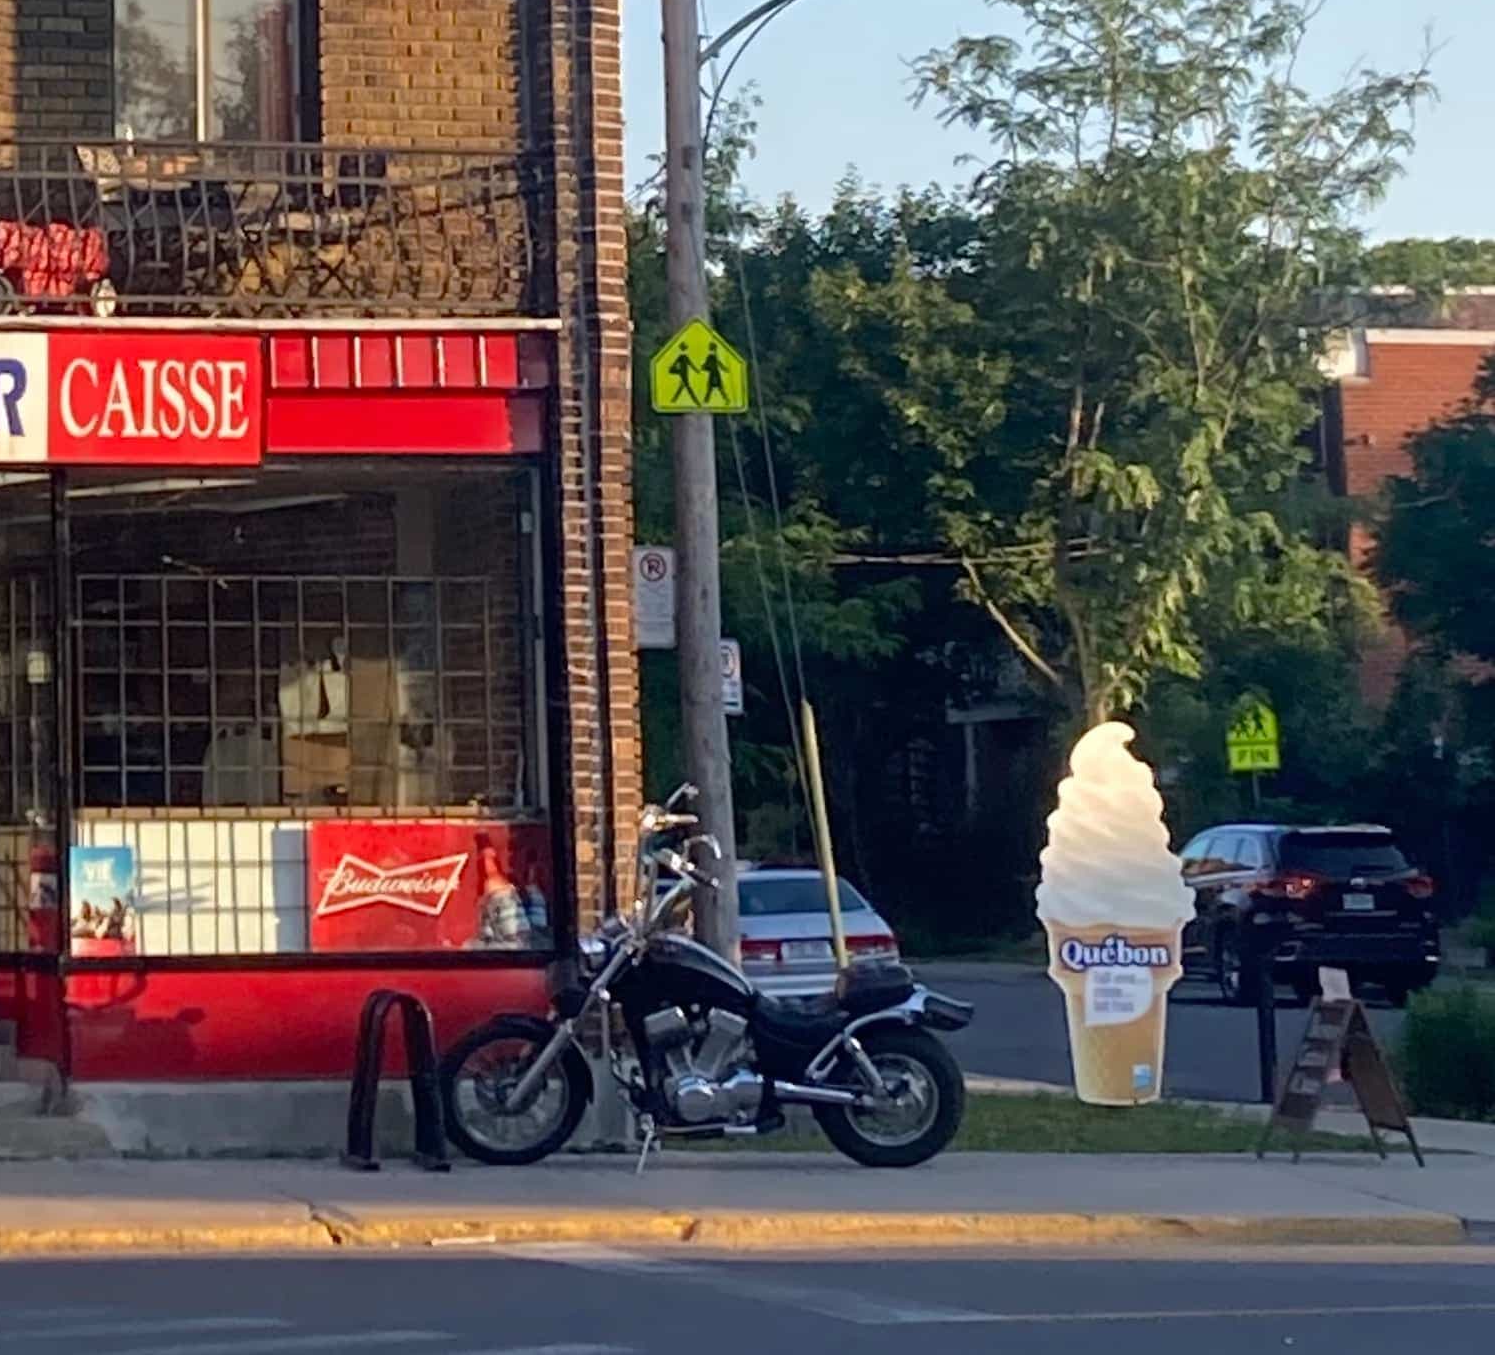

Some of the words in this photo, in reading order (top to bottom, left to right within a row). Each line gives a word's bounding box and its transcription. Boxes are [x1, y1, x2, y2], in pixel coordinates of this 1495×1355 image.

[60, 357, 249, 439] CAISSE
[318, 867, 460, 897] Budweiser
[1061, 937, 1168, 971] Québon
